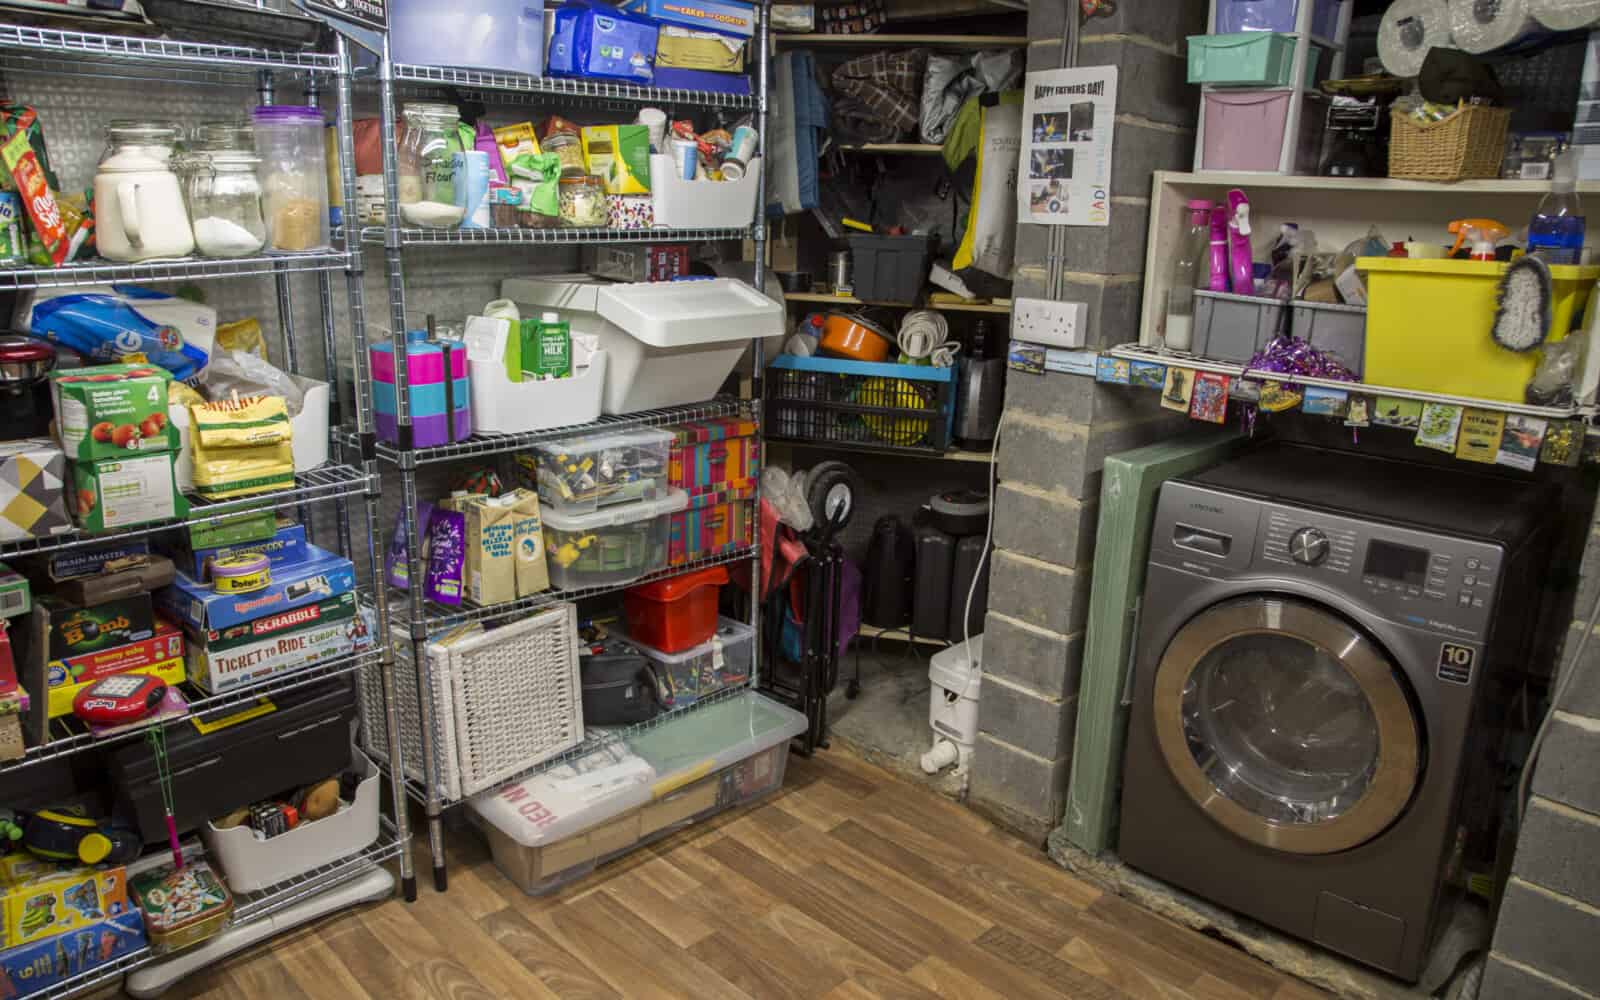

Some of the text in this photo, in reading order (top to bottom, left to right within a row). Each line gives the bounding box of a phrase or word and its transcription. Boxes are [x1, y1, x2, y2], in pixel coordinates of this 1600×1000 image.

[256, 607, 319, 631] SCRABBLE
[215, 649, 263, 673] TICKET
[278, 637, 306, 655] RIDE
[1445, 647, 1470, 665] 10
